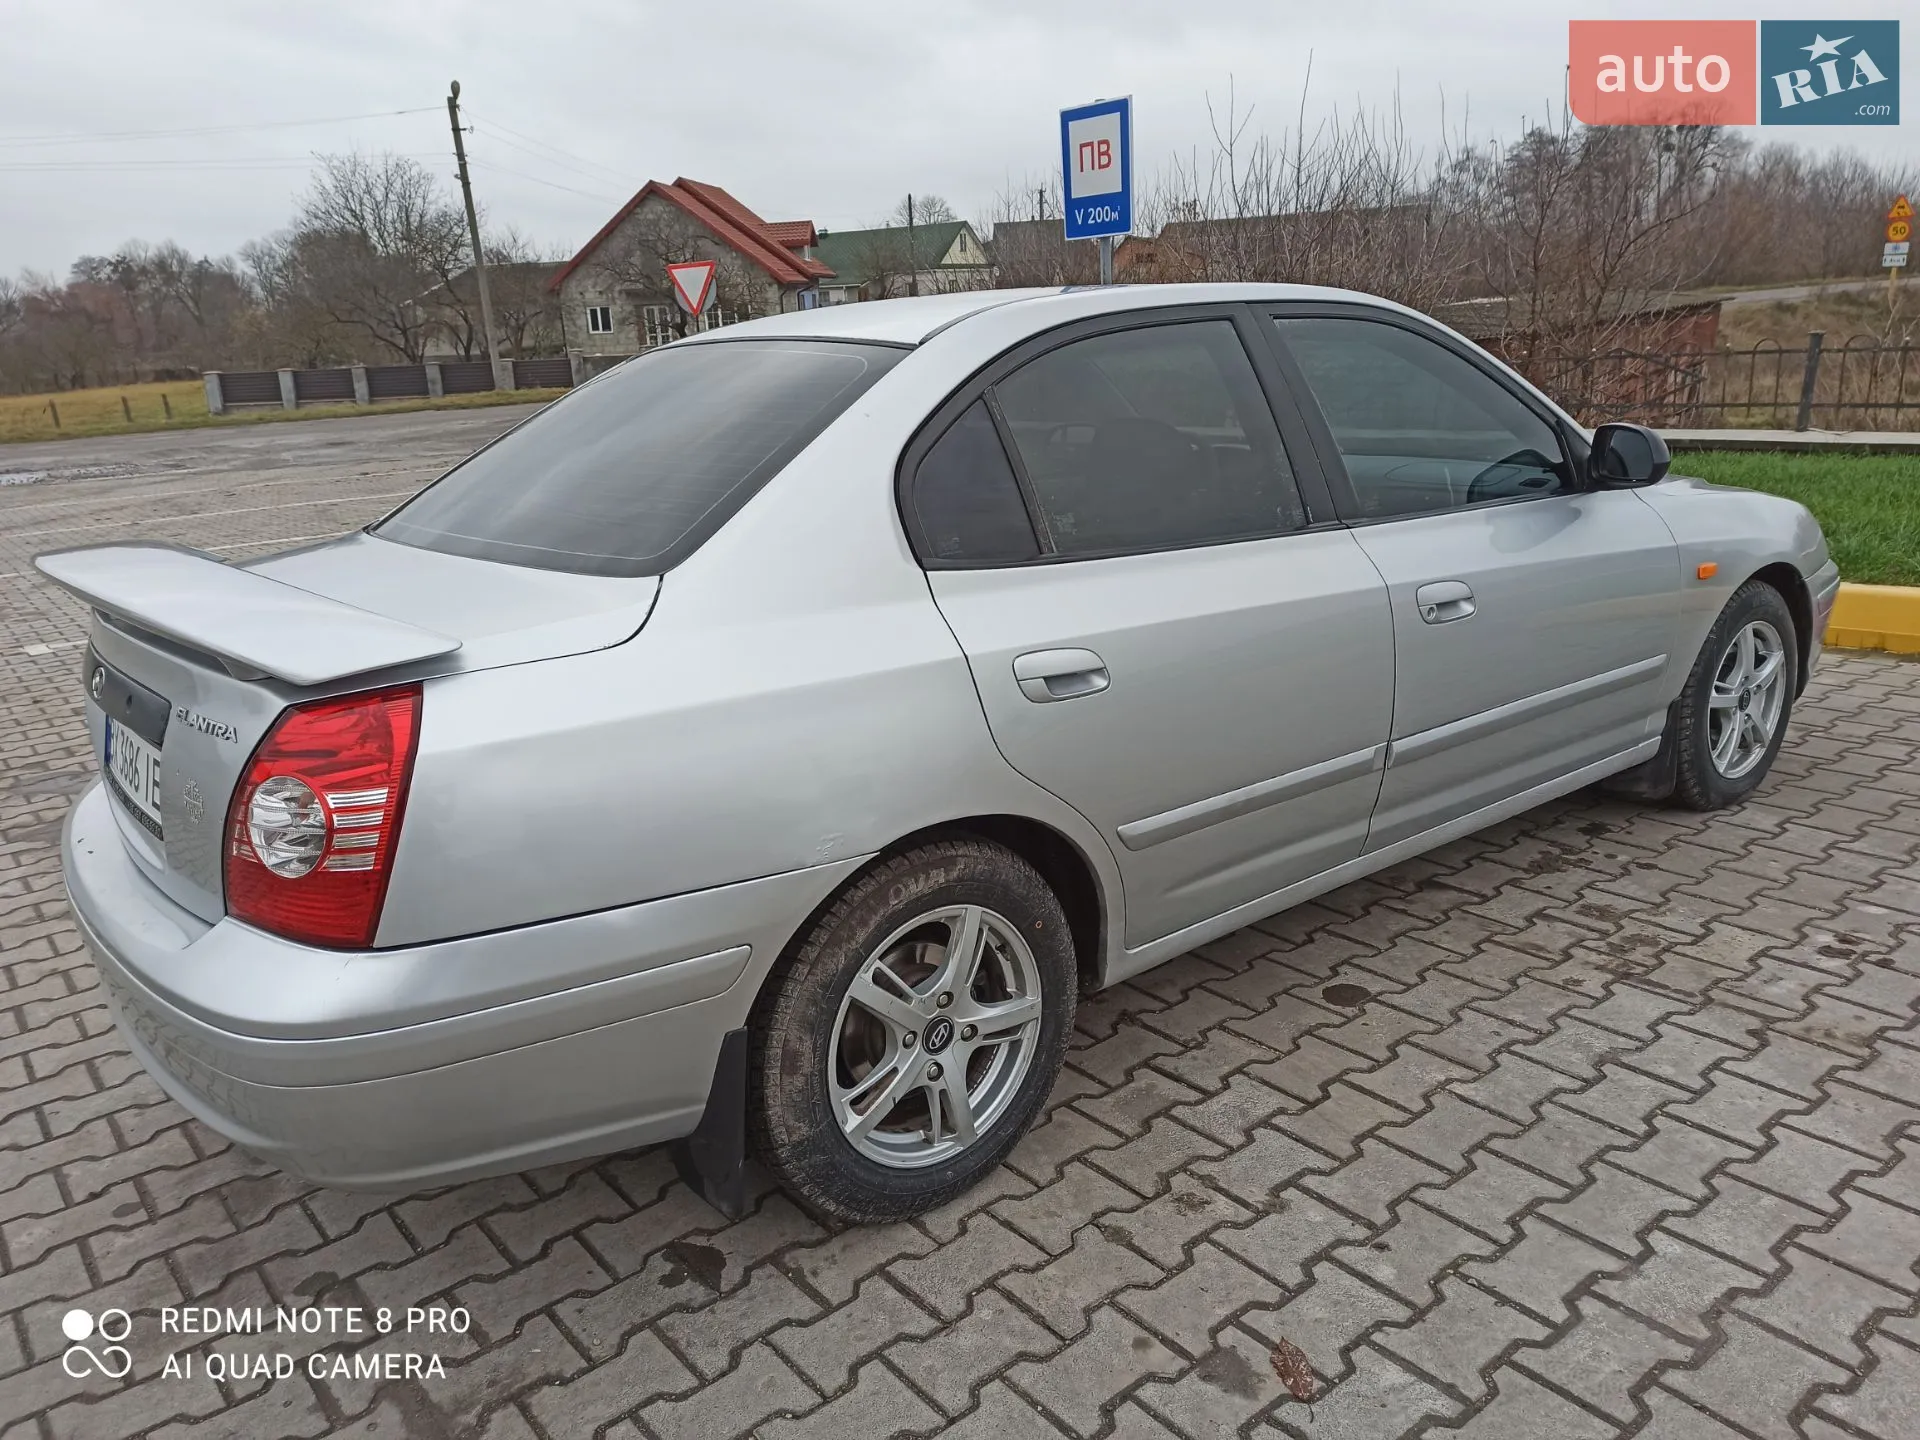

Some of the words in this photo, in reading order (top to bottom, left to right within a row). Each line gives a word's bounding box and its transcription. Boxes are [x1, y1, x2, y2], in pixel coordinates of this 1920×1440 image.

[1078, 138, 1112, 173] ПВ
[1074, 208, 1084, 225] V
[1892, 226, 1907, 236] 50
[176, 706, 238, 744] ELANTRA
